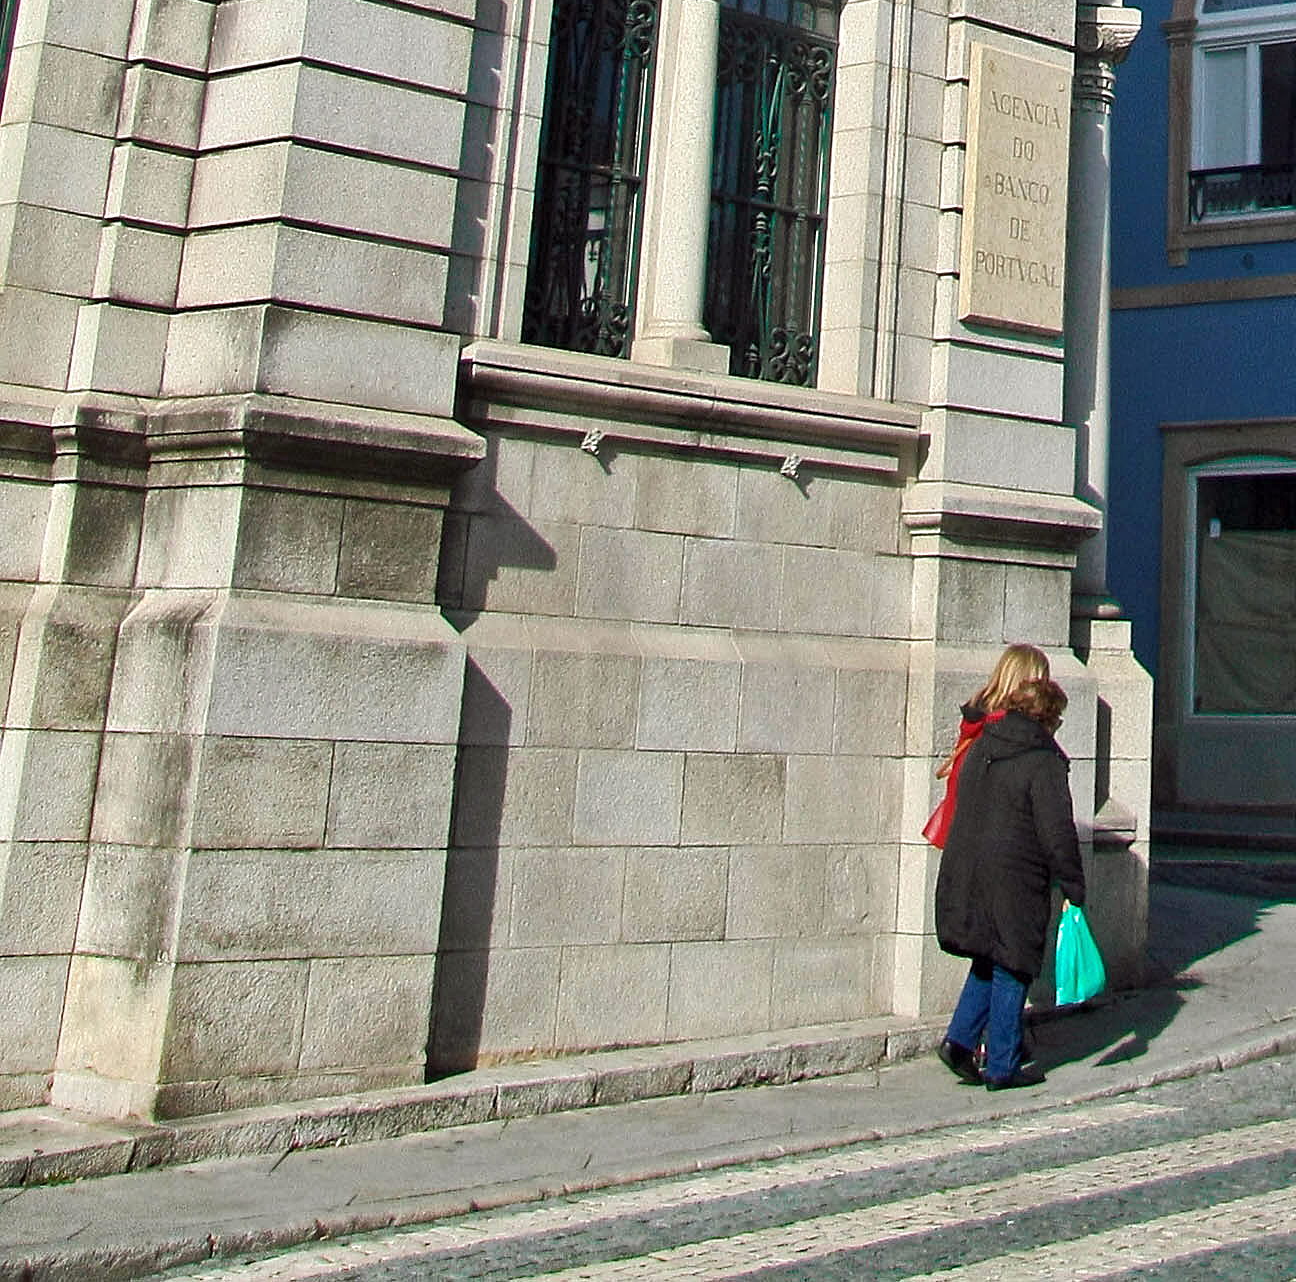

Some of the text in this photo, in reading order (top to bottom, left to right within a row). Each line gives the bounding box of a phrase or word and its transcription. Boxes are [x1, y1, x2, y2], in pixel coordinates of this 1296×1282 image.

[1012, 136, 1034, 162] DO
[994, 172, 1049, 205] BANCO
[1009, 217, 1031, 242] DE
